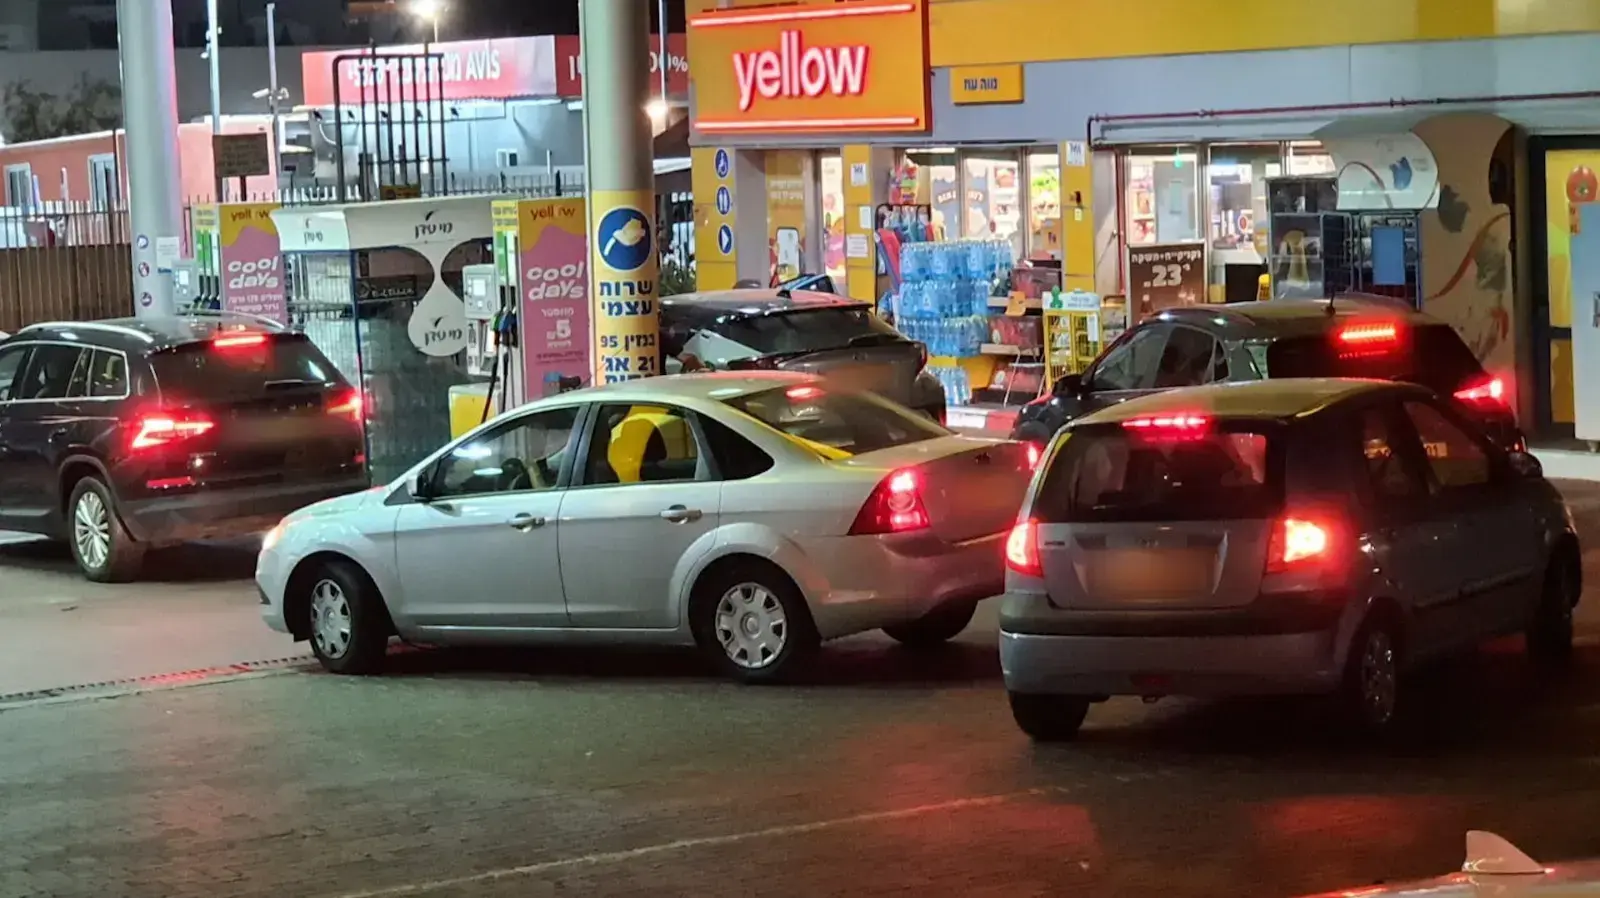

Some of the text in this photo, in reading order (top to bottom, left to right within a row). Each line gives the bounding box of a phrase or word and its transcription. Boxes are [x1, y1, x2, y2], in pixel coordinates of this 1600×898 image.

[465, 48, 501, 81] AVIS
[732, 29, 869, 113] yellow
[227, 255, 279, 273] cool
[526, 260, 585, 282] cool
[229, 271, 279, 289] days
[527, 278, 584, 300] days
[599, 280, 653, 296] שרות
[601, 299, 652, 316] עצמי
[600, 332, 656, 352] בנזין 95
[637, 355, 656, 371] 21
